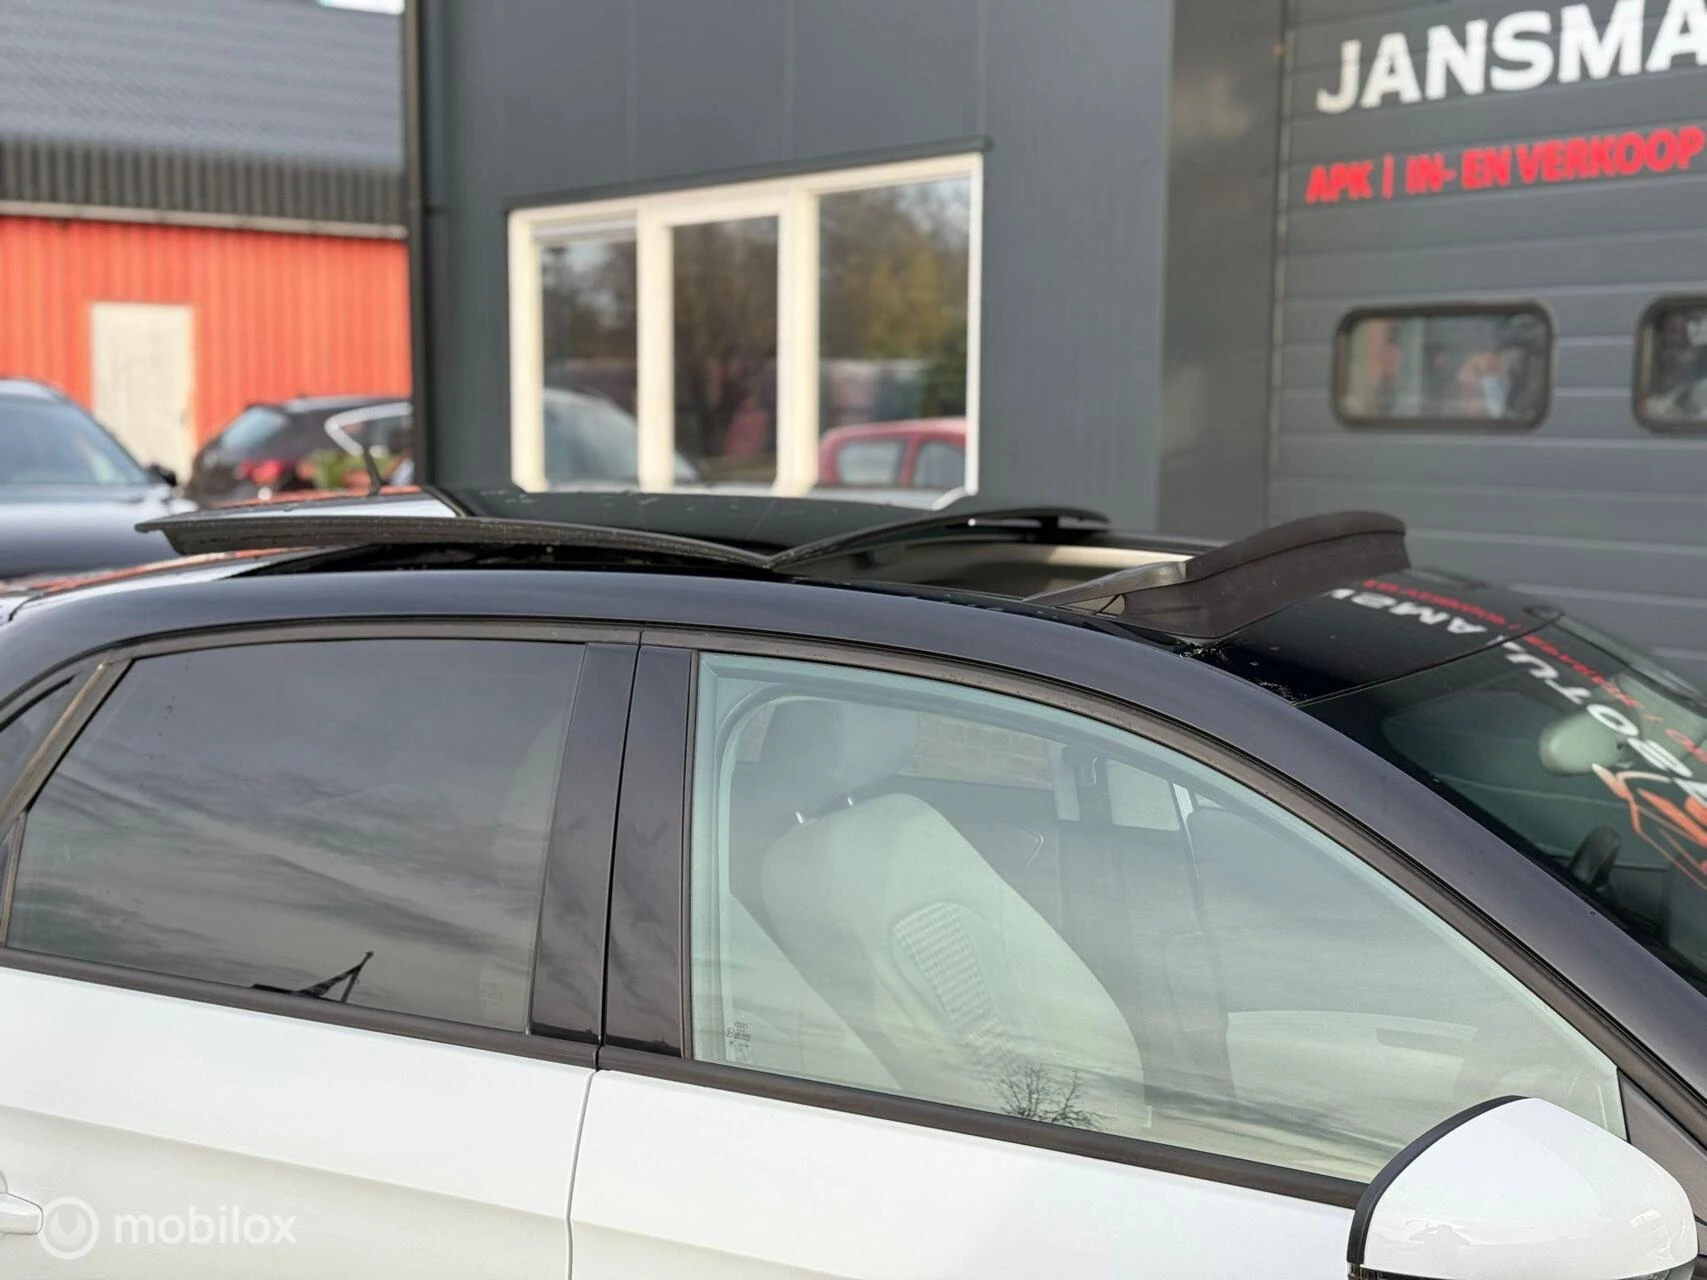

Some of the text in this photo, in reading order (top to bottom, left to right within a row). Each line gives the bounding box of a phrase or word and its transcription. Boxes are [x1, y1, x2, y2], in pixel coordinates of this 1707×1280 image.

[1316, 0, 1707, 114] JANSMA
[1305, 160, 1373, 204] APK
[1405, 151, 1456, 195] IN-
[1461, 144, 1512, 190] EN
[1516, 125, 1705, 185] VERKOOP
